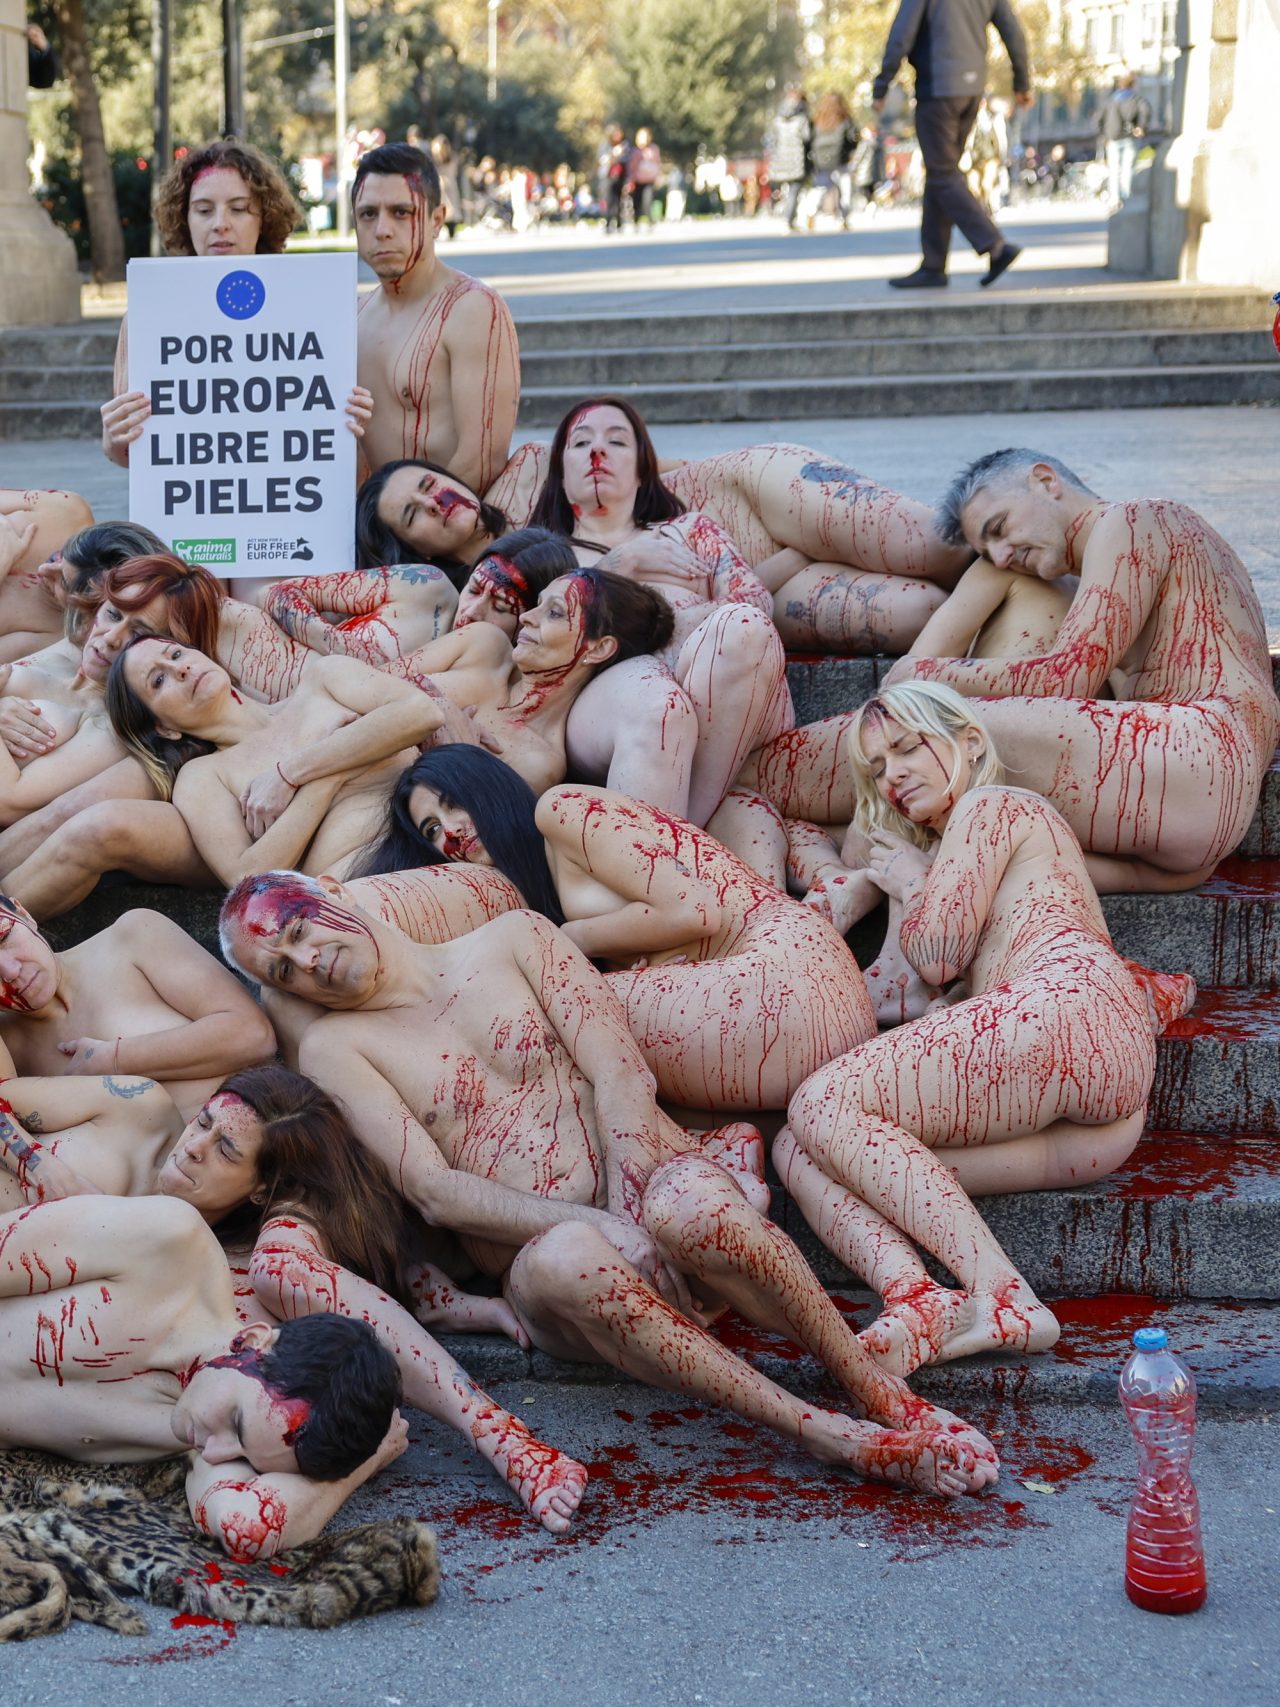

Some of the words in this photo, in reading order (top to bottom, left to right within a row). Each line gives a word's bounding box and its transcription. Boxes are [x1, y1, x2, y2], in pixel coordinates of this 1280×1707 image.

[160, 335, 233, 365] POR
[246, 331, 324, 362] UNA
[150, 375, 336, 416] EUROPA
[151, 431, 269, 466] LIBRE
[283, 429, 336, 463] DE
[164, 476, 323, 515] PIELES
[193, 541, 232, 553] anima
[193, 552, 233, 561] naturalis
[247, 543, 267, 551] FUR
[270, 542, 296, 550] FREE
[247, 551, 288, 560] EUROPE
